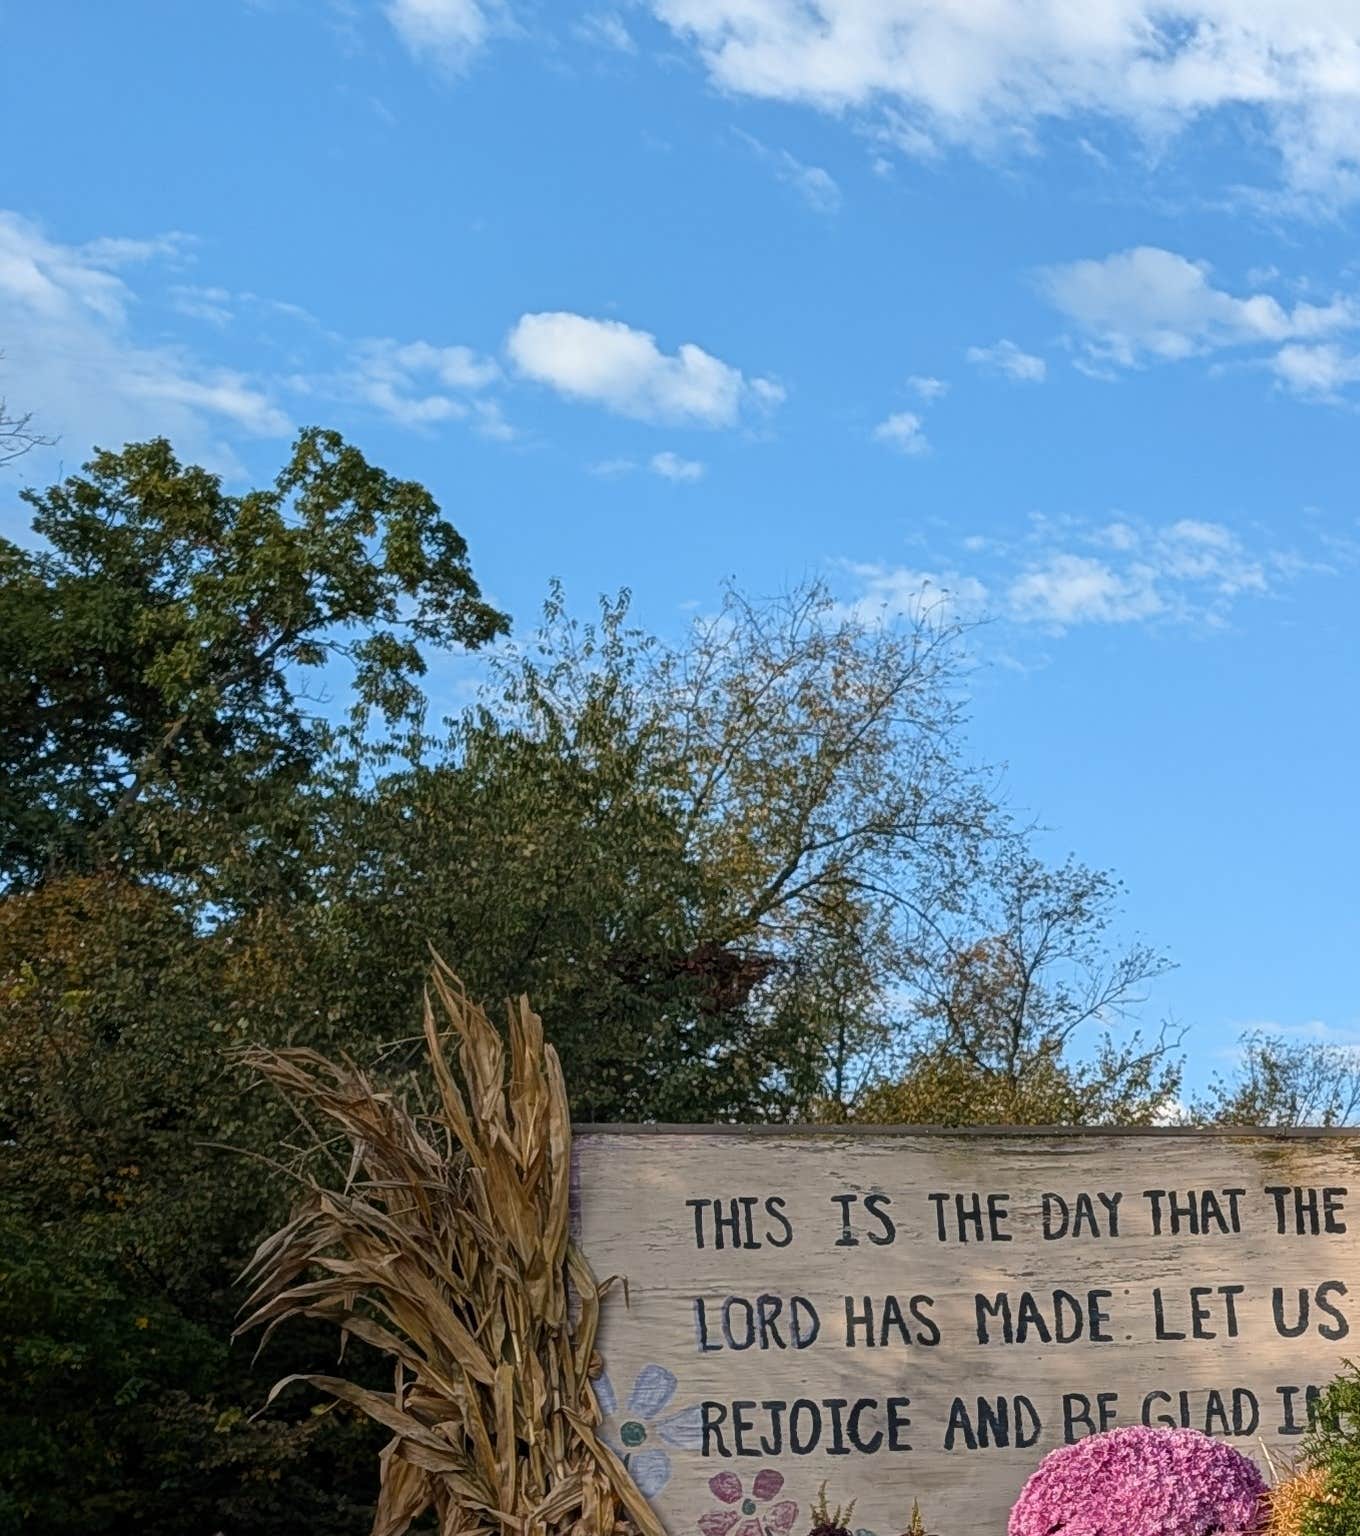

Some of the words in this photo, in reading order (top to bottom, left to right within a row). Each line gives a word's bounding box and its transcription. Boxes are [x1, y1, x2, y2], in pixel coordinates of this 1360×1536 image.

[686, 1197, 793, 1249] THIS
[831, 1194, 895, 1246] IS
[928, 1192, 1013, 1242] THE
[1041, 1191, 1123, 1240] DAY
[1143, 1188, 1246, 1235] THAT
[1264, 1186, 1348, 1235] THE
[694, 1294, 820, 1351] LORD
[845, 1295, 940, 1347] HAS
[975, 1289, 1113, 1345] MADE
[1153, 1285, 1245, 1340] LET
[1272, 1280, 1350, 1341] US
[701, 1397, 912, 1457] REJOICE
[944, 1395, 1042, 1450] AND
